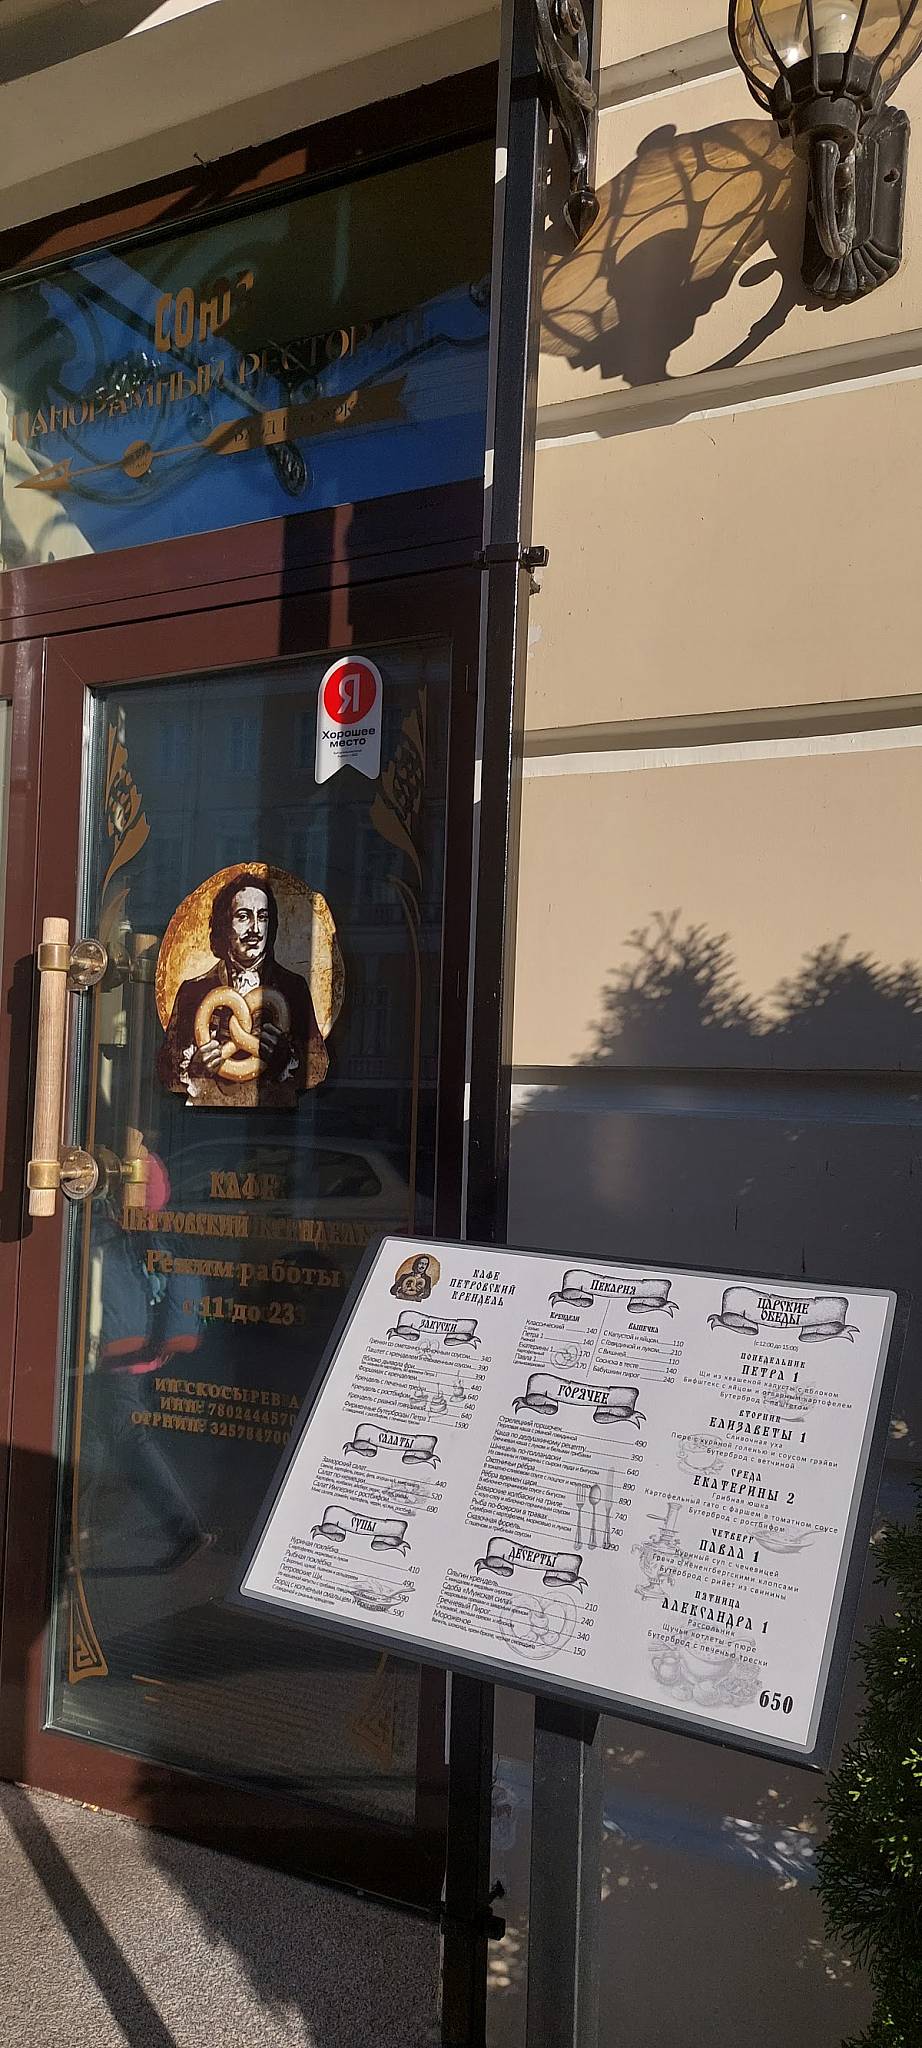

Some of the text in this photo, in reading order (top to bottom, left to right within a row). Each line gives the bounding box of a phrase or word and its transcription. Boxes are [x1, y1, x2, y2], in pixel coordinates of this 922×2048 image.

[337, 673, 360, 714] Я
[322, 727, 375, 740] Хорошее
[330, 738, 366, 748] место
[209, 1170, 281, 1199] КАФЕ
[122, 1206, 249, 1238] ПЕТРОВСКИЙ
[147, 1249, 341, 1288] Режим работы
[472, 1269, 500, 1280] КАФЕ
[449, 1278, 516, 1295] ПЕТРОВСКИЙ
[451, 1290, 503, 1306] КРЕНДЕЛЬ
[757, 1297, 809, 1314] ЦАРСКИЕ
[201, 1295, 225, 1318] 11
[231, 1303, 262, 1325] до
[268, 1301, 296, 1326] 23
[758, 1309, 801, 1328] ОБЕДЫ
[417, 1319, 457, 1335] ЗАКУСКИ
[740, 1352, 805, 1368] ПОНЕДЕЛЬНИК
[741, 1364, 784, 1380] ПЕТРА
[557, 1384, 610, 1404] ГОРЯЧЕЕ
[683, 1376, 719, 1388] Бифштекс
[727, 1384, 752, 1392] яйцом
[803, 1396, 852, 1408] картофелем
[724, 1375, 761, 1385] квашеной
[763, 1382, 795, 1391] капусты
[804, 1388, 838, 1398] яблоком
[720, 1391, 760, 1404] Бутерброд
[769, 1400, 808, 1410] паштетом
[738, 1409, 781, 1423] ВТОРНИК
[709, 1416, 792, 1440] ЕЛИЗАВЕТЫ
[725, 1432, 767, 1445] Сливочная
[378, 1433, 414, 1448] САЛАТЫ
[671, 1431, 692, 1441] Пюре
[699, 1438, 732, 1448] куриной
[734, 1444, 768, 1455] голенью
[778, 1452, 806, 1462] соусом
[809, 1458, 838, 1467] грэйви
[706, 1447, 747, 1461] Бутерброд
[757, 1458, 794, 1469] ветчиной
[626, 1468, 639, 1476] 640
[731, 1468, 761, 1483] СРЕДА
[693, 1474, 779, 1501] ЕКАТЕРИНЫ
[507, 1491, 535, 1501] колбаски
[544, 1499, 563, 1508] гриле
[614, 1512, 627, 1521] 740
[644, 1487, 700, 1504] Картофельный
[729, 1505, 760, 1517] фаршем
[771, 1515, 811, 1528] томатном
[814, 1524, 838, 1534] соусе
[711, 1492, 768, 1509] Грибная юшка
[351, 1516, 377, 1535] СУПЫ
[688, 1506, 730, 1522] Бутерброд
[739, 1518, 785, 1533] ростбифом
[712, 1528, 754, 1544] ЧЕТВЕРГ
[507, 1546, 557, 1568] ДЕСЕРТЫ
[699, 1539, 744, 1560] ПАВЛА
[408, 1565, 420, 1574] 410
[652, 1552, 674, 1564] Греча
[758, 1579, 799, 1592] клопсами
[673, 1548, 709, 1561] Куриный
[735, 1563, 778, 1577] чечевицей
[402, 1579, 414, 1588] 490
[446, 1568, 469, 1579] Ольгин
[469, 1575, 498, 1586] крендель
[584, 1602, 598, 1612] 210
[659, 1564, 701, 1582] Бутерброд
[710, 1578, 735, 1588] рийет
[750, 1587, 786, 1600] свинины
[442, 1581, 461, 1592] Сдоба
[580, 1616, 594, 1627] 240
[694, 1590, 740, 1609] ПЯТНИЦА
[437, 1595, 590, 1641] Гречневый Пирог 340
[661, 1597, 752, 1630] АЛЕКСАНДРА
[432, 1608, 471, 1625] Мороженое
[573, 1646, 586, 1656] 150
[662, 1623, 688, 1635] Щучьи
[690, 1631, 724, 1645] котлеты
[734, 1643, 756, 1653] пюре
[687, 1618, 735, 1637] Рассольник
[647, 1629, 690, 1648] Бутерброд
[700, 1645, 736, 1659] печенью
[739, 1654, 768, 1666] трески
[759, 1690, 793, 1714] 650
